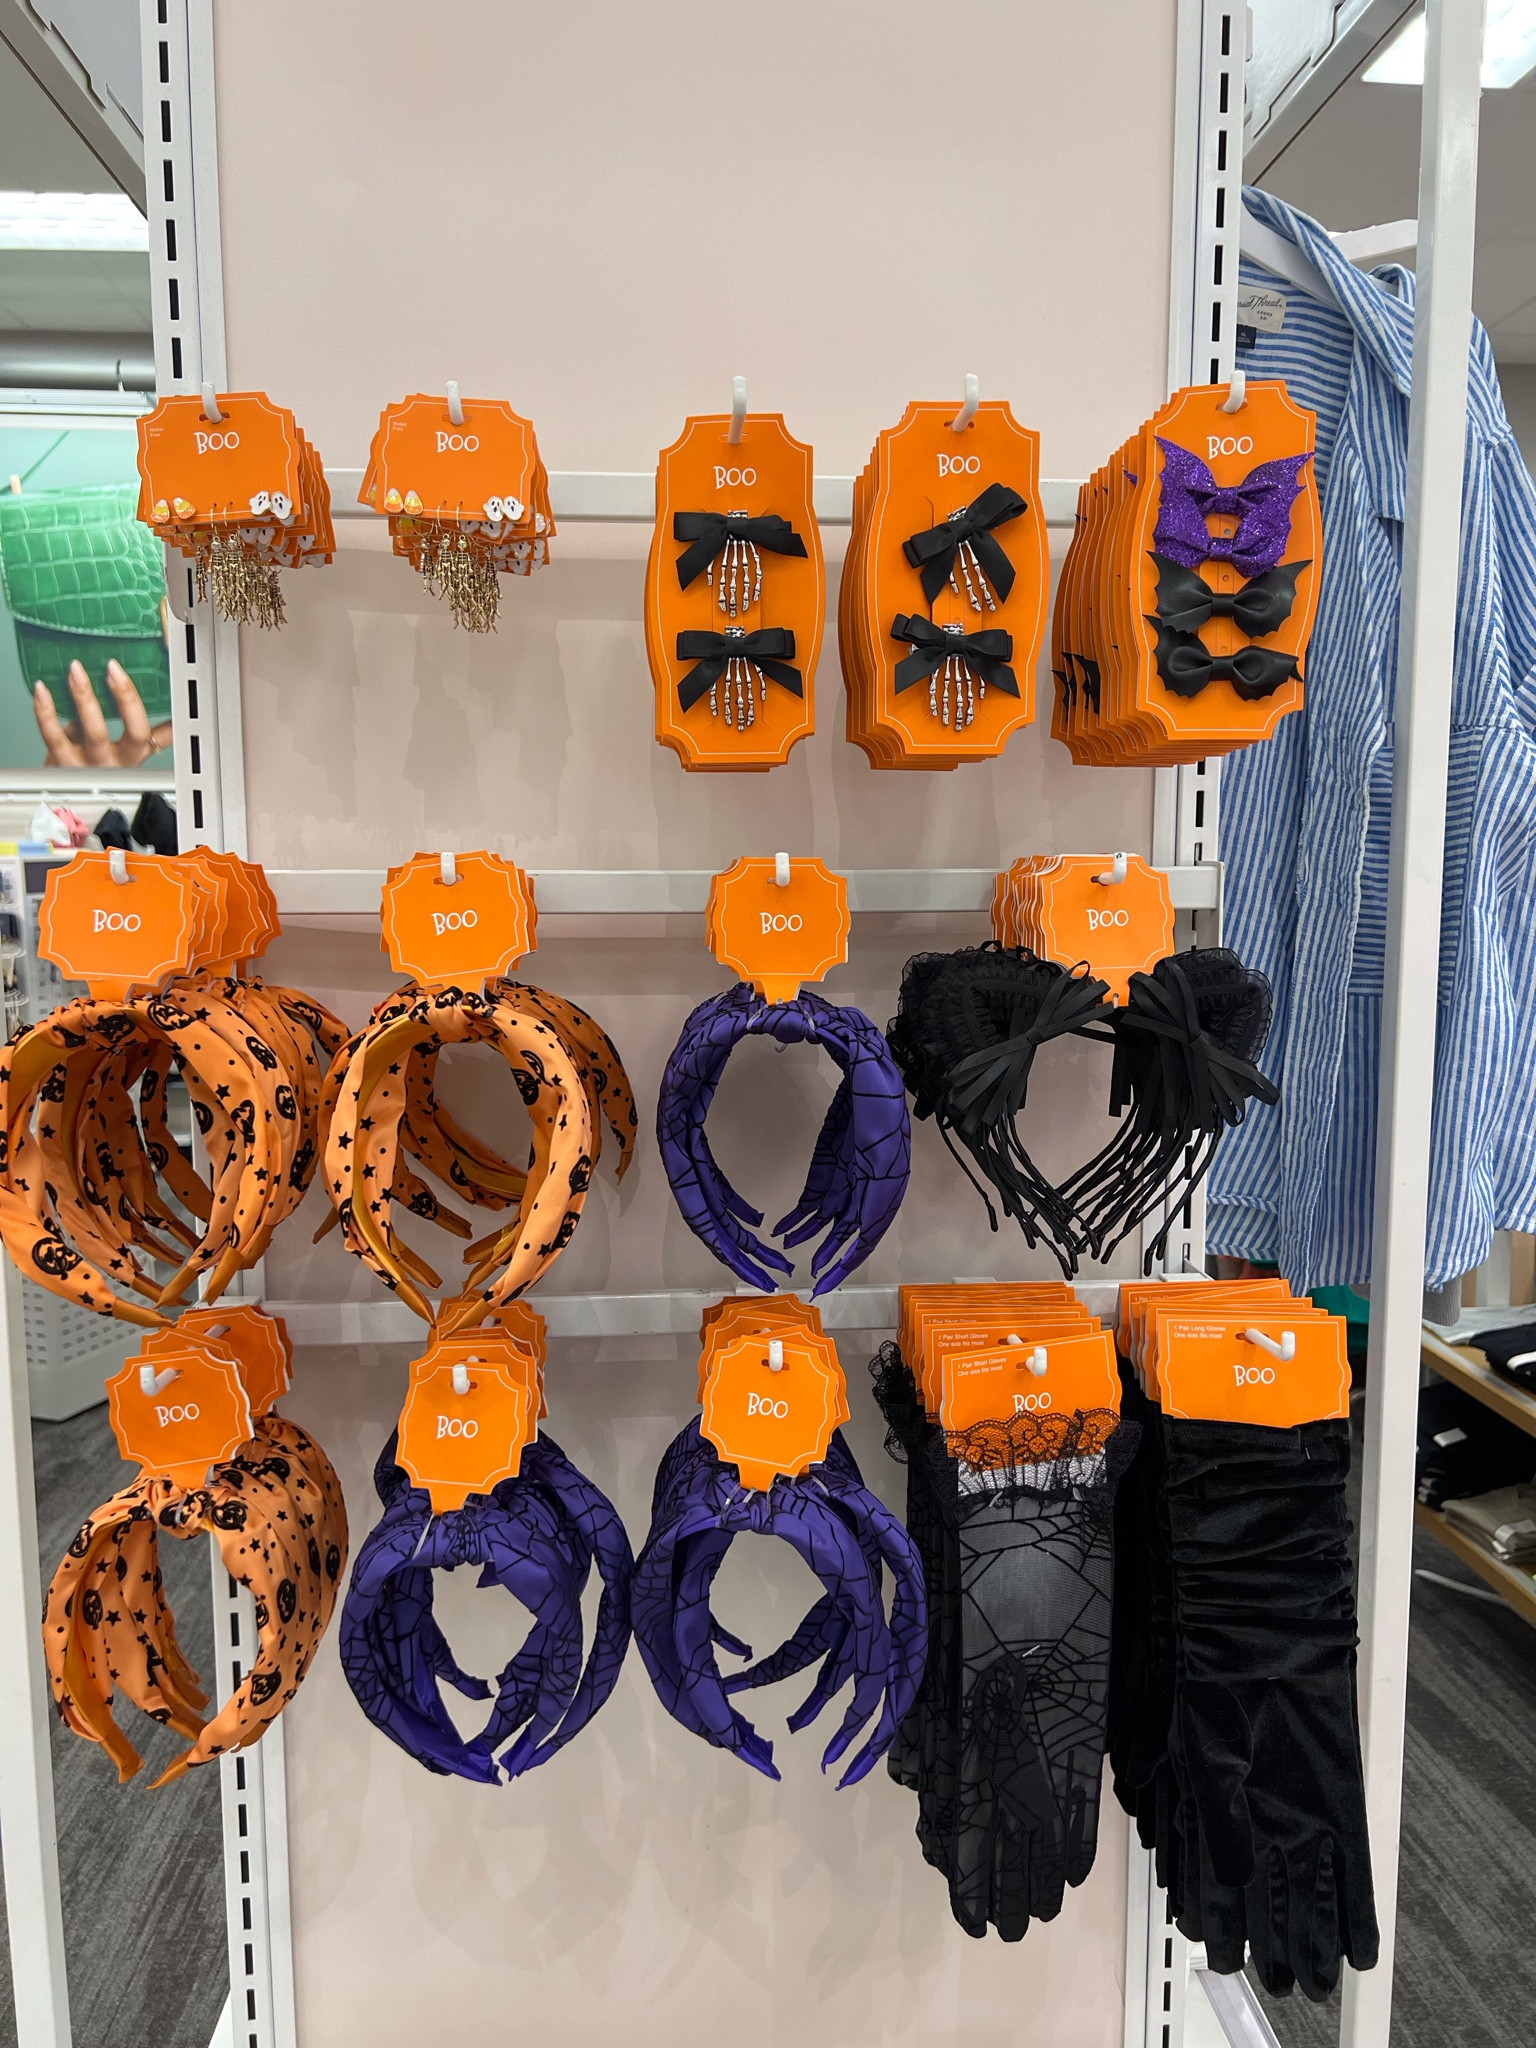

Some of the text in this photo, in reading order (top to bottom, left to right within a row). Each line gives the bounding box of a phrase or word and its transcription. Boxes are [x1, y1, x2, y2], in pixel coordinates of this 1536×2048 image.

[1191, 1325, 1206, 1333] Long
[974, 1359, 988, 1367] Short
[989, 1357, 1007, 1365] Gloves
